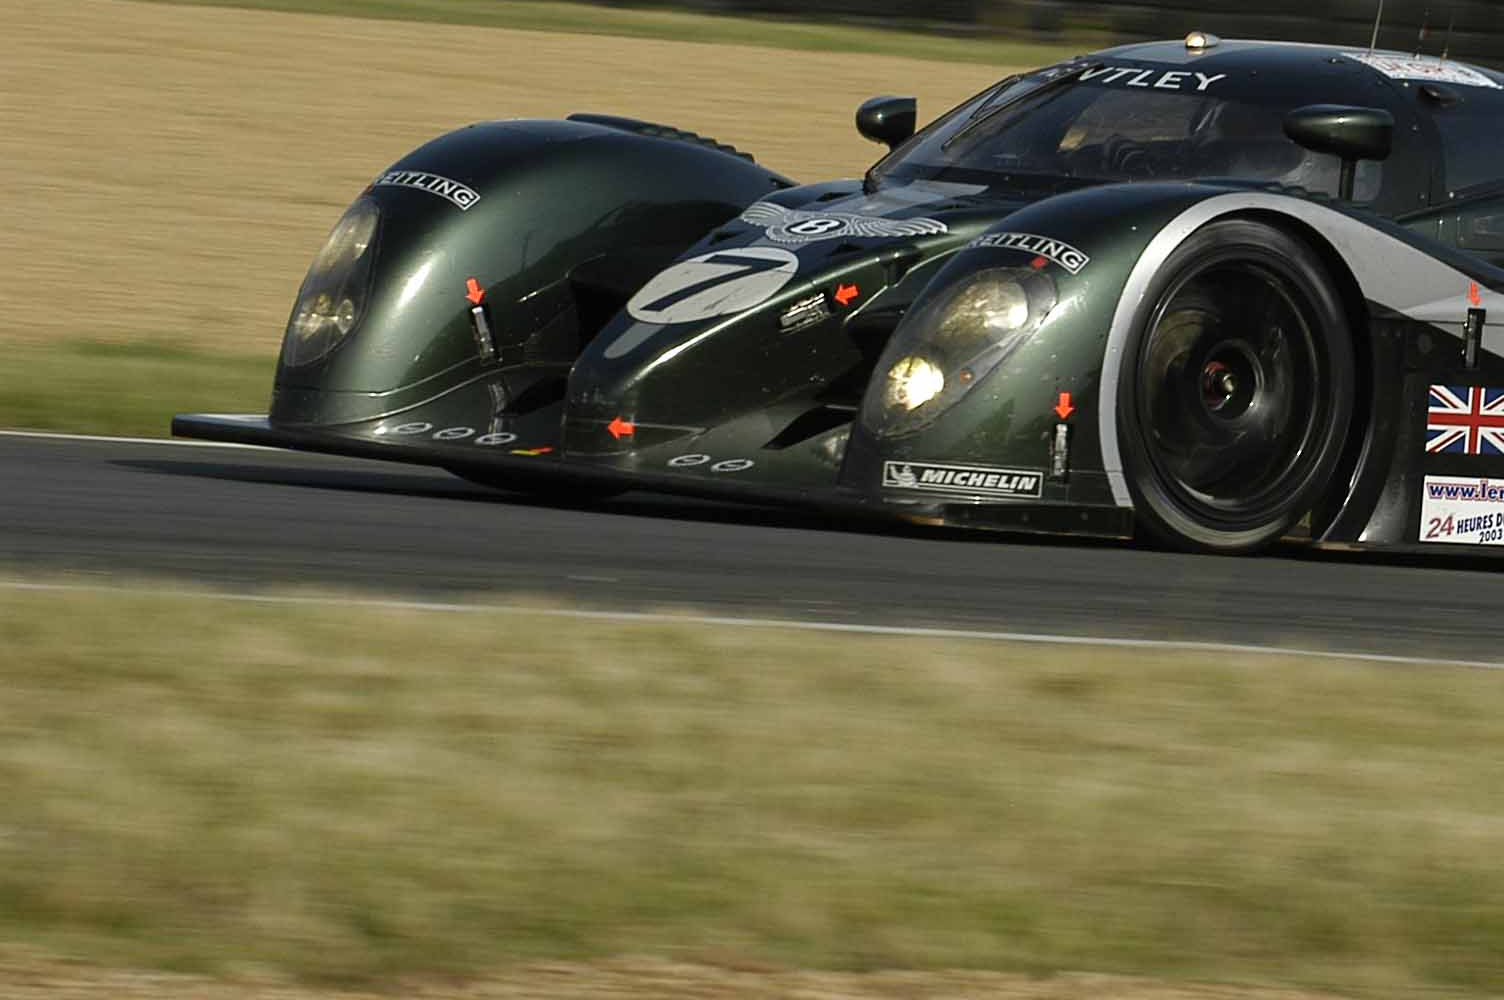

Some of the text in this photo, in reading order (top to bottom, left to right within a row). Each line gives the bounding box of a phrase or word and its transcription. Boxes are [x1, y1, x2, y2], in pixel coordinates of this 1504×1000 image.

[639, 254, 792, 312] 7
[919, 469, 1037, 490] MICHELIN
[1425, 514, 1455, 539] 24
[1456, 514, 1494, 534] HEURES
[1479, 528, 1503, 543] 2003
